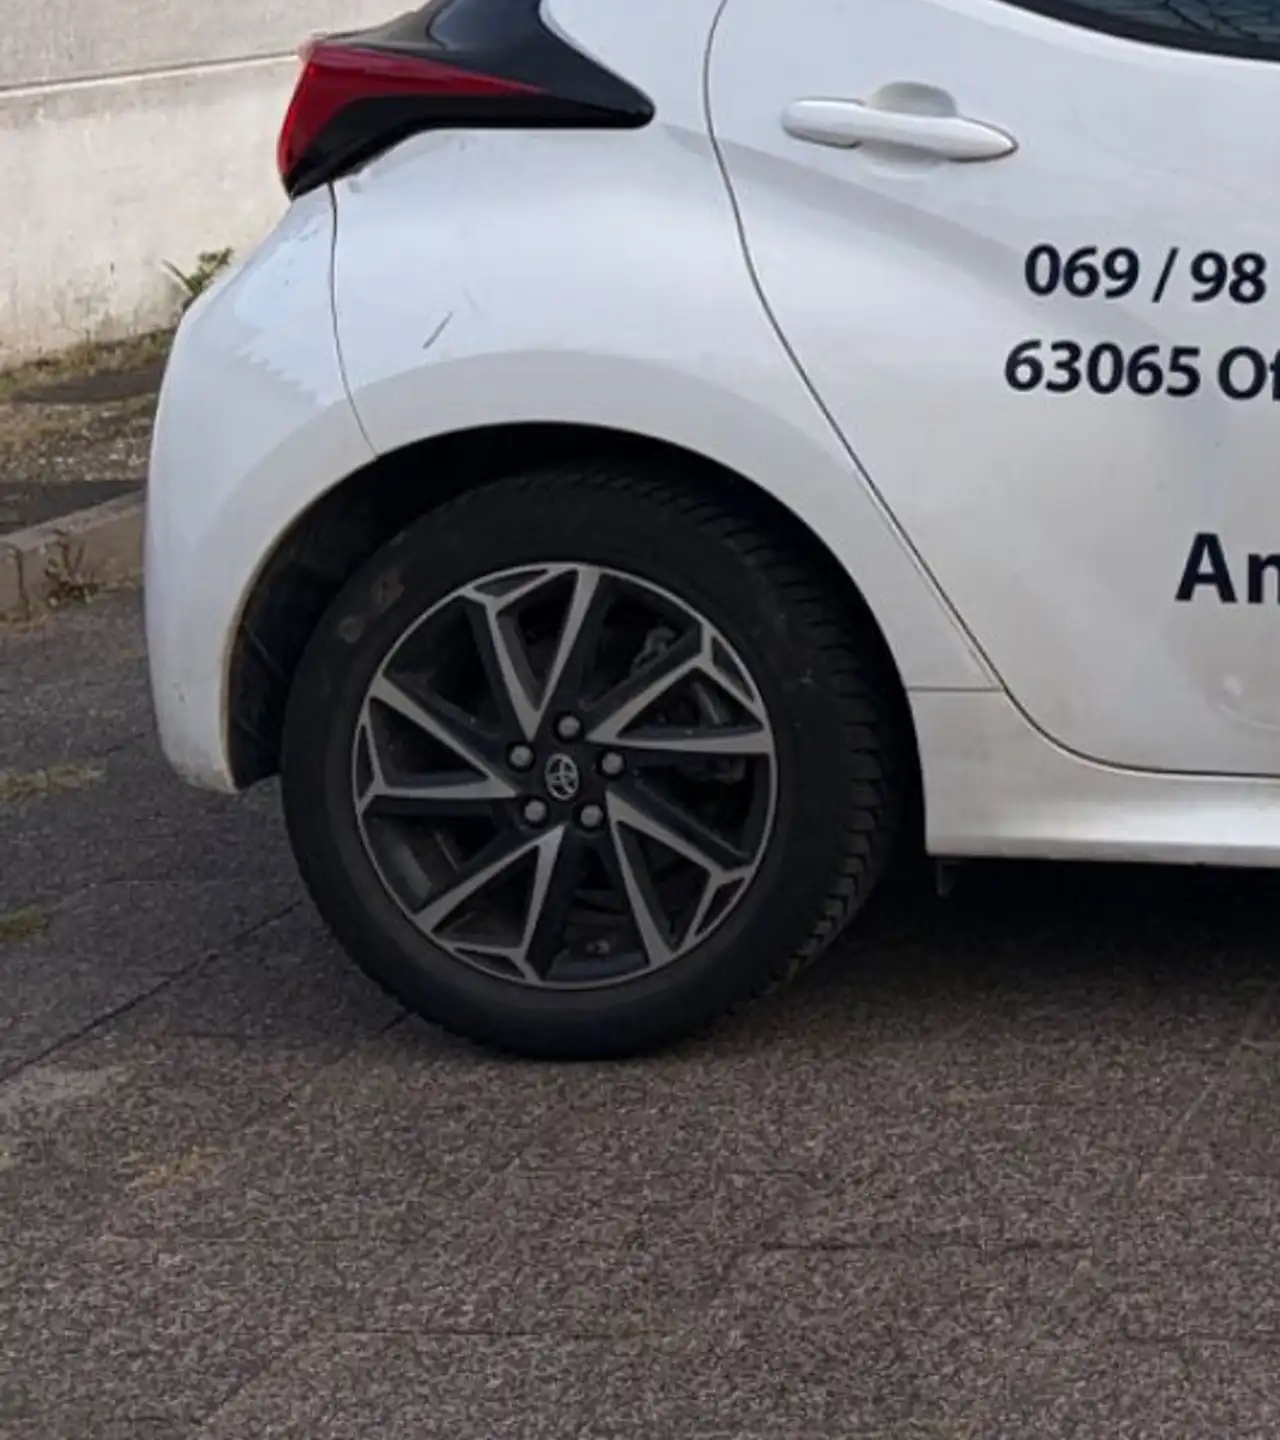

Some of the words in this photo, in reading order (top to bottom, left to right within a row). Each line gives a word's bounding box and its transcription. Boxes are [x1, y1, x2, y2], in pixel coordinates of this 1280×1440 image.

[1024, 244, 1140, 299] 069
[1190, 251, 1266, 304] 98
[1005, 340, 1201, 398] 63065
